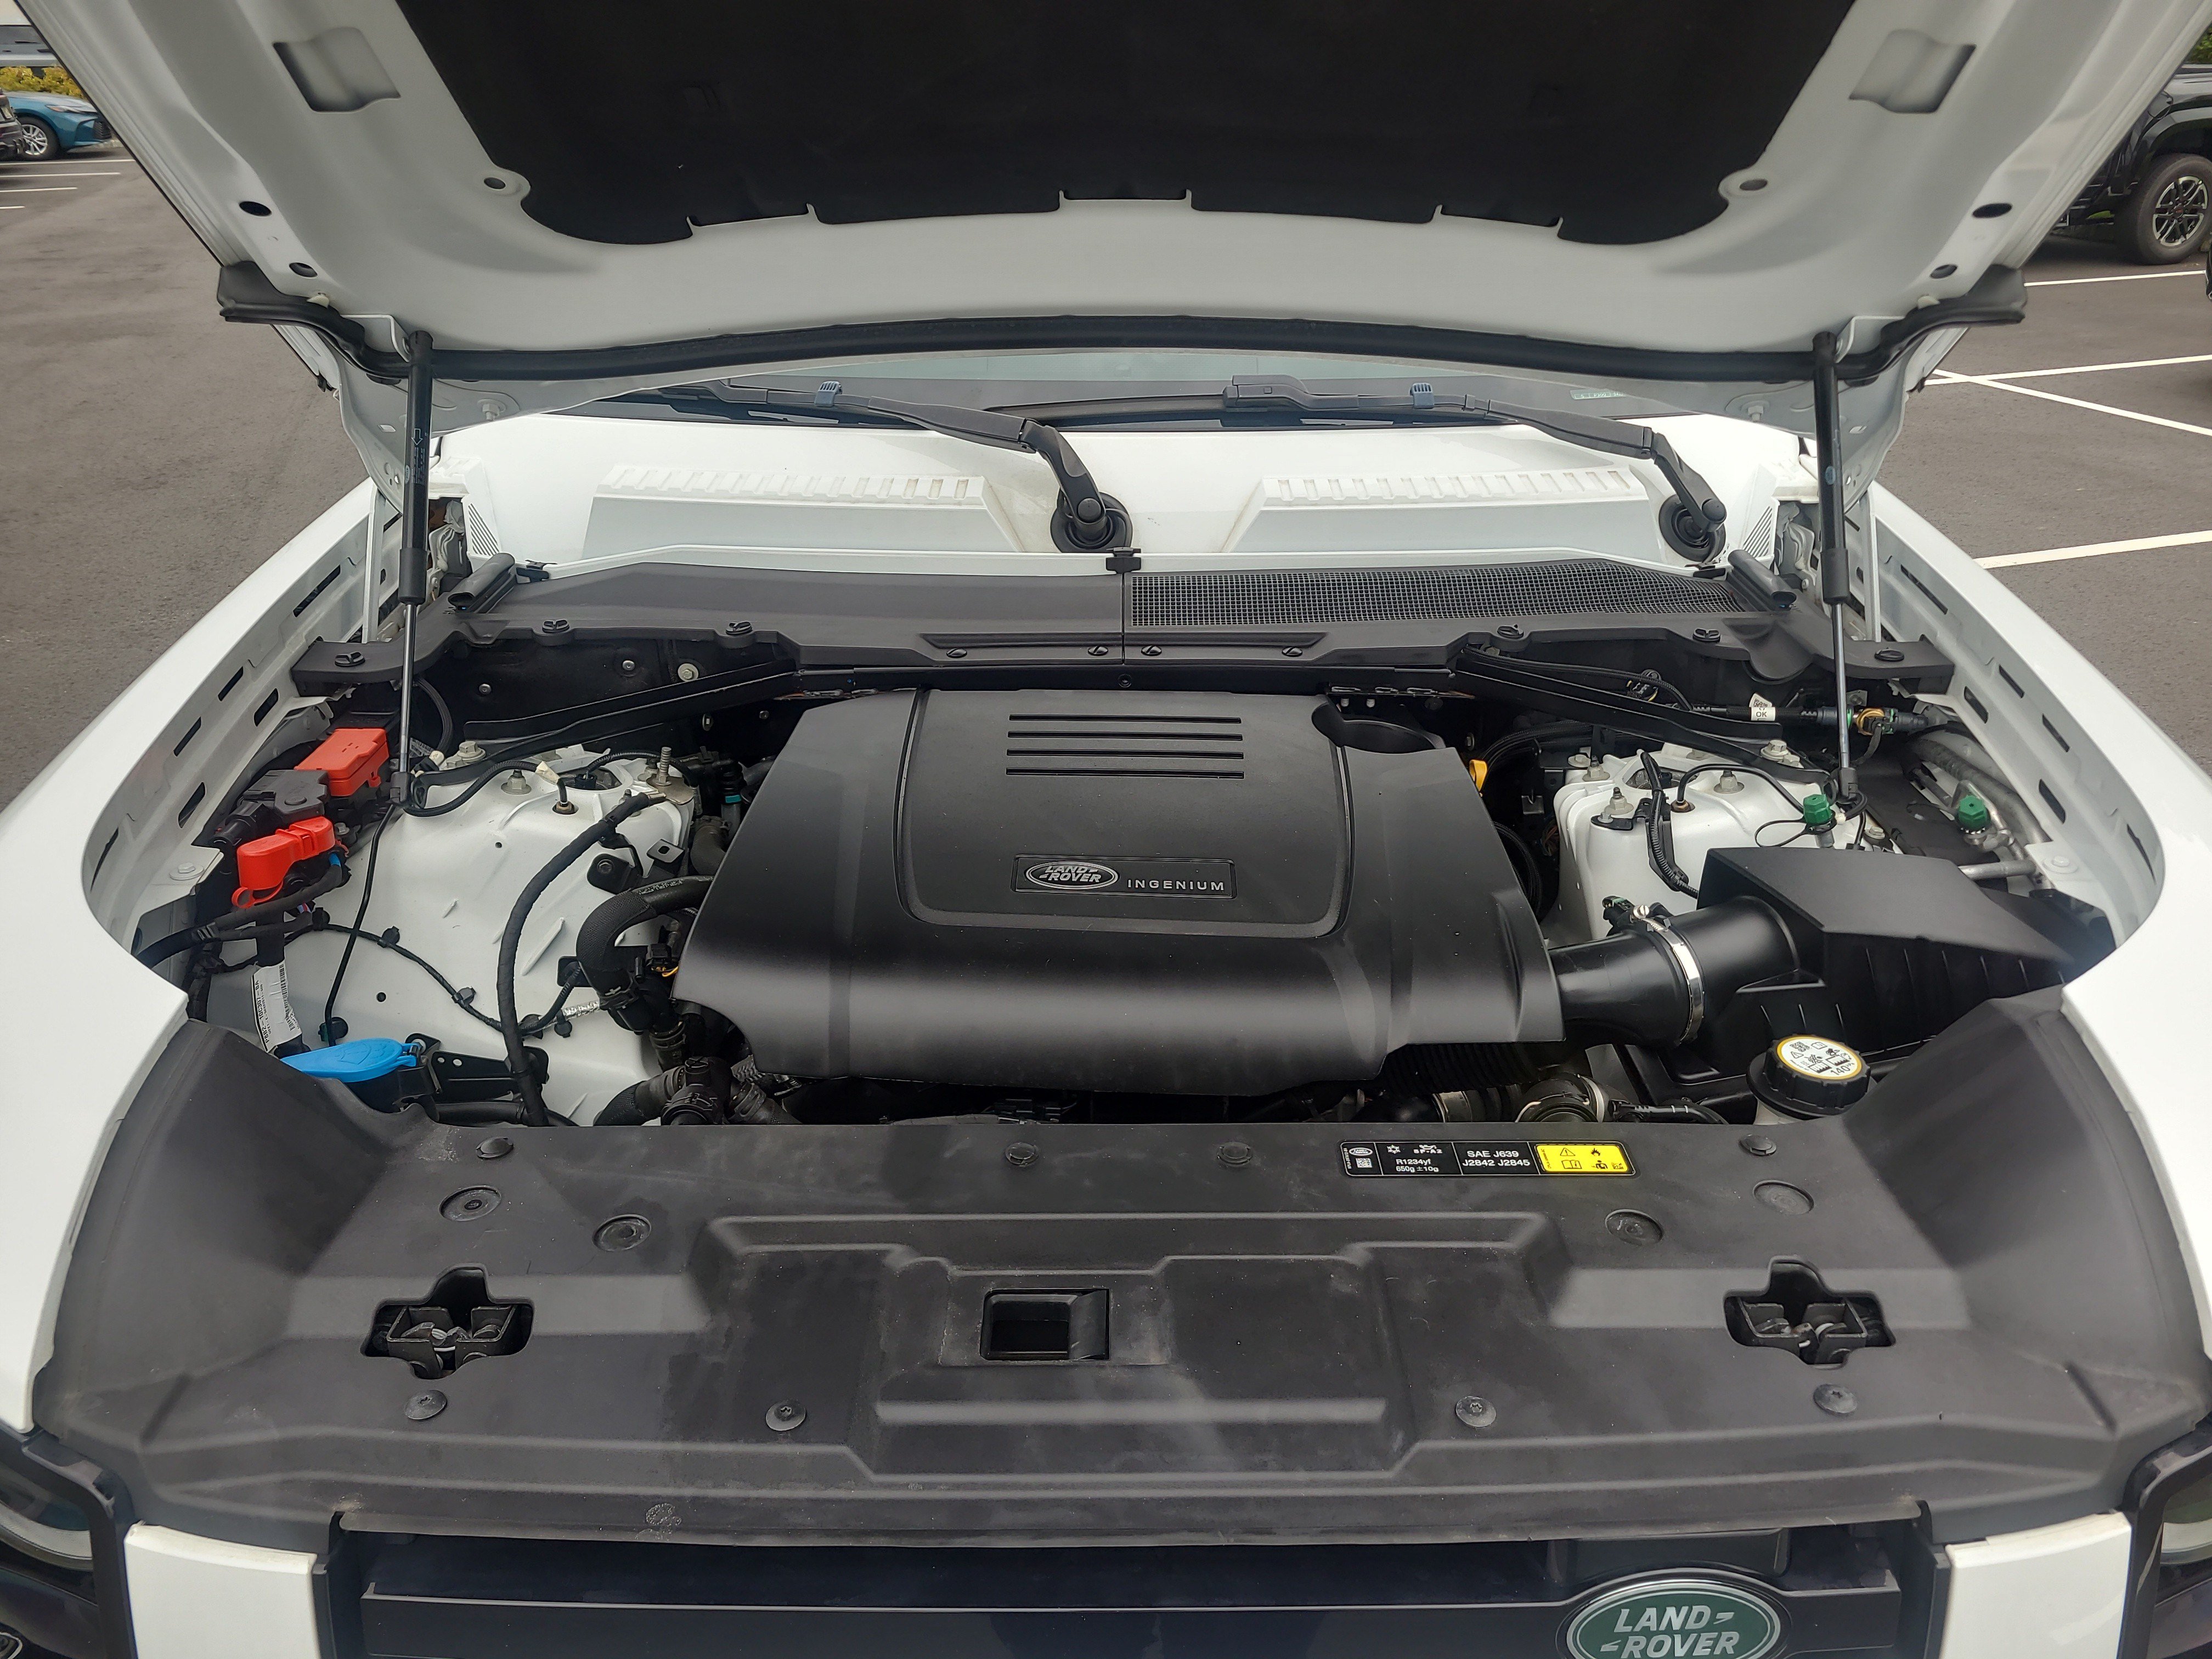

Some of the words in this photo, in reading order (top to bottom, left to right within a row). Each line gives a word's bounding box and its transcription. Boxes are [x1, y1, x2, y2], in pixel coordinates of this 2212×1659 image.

[1045, 865, 1091, 873] LAND
[1048, 872, 1102, 883] ROVER
[1127, 879, 1224, 891] INGENIUM
[1830, 1065, 1850, 1075] 140
[1613, 1605, 1711, 1633] LAND
[1621, 1631, 1740, 1659] ROVER
